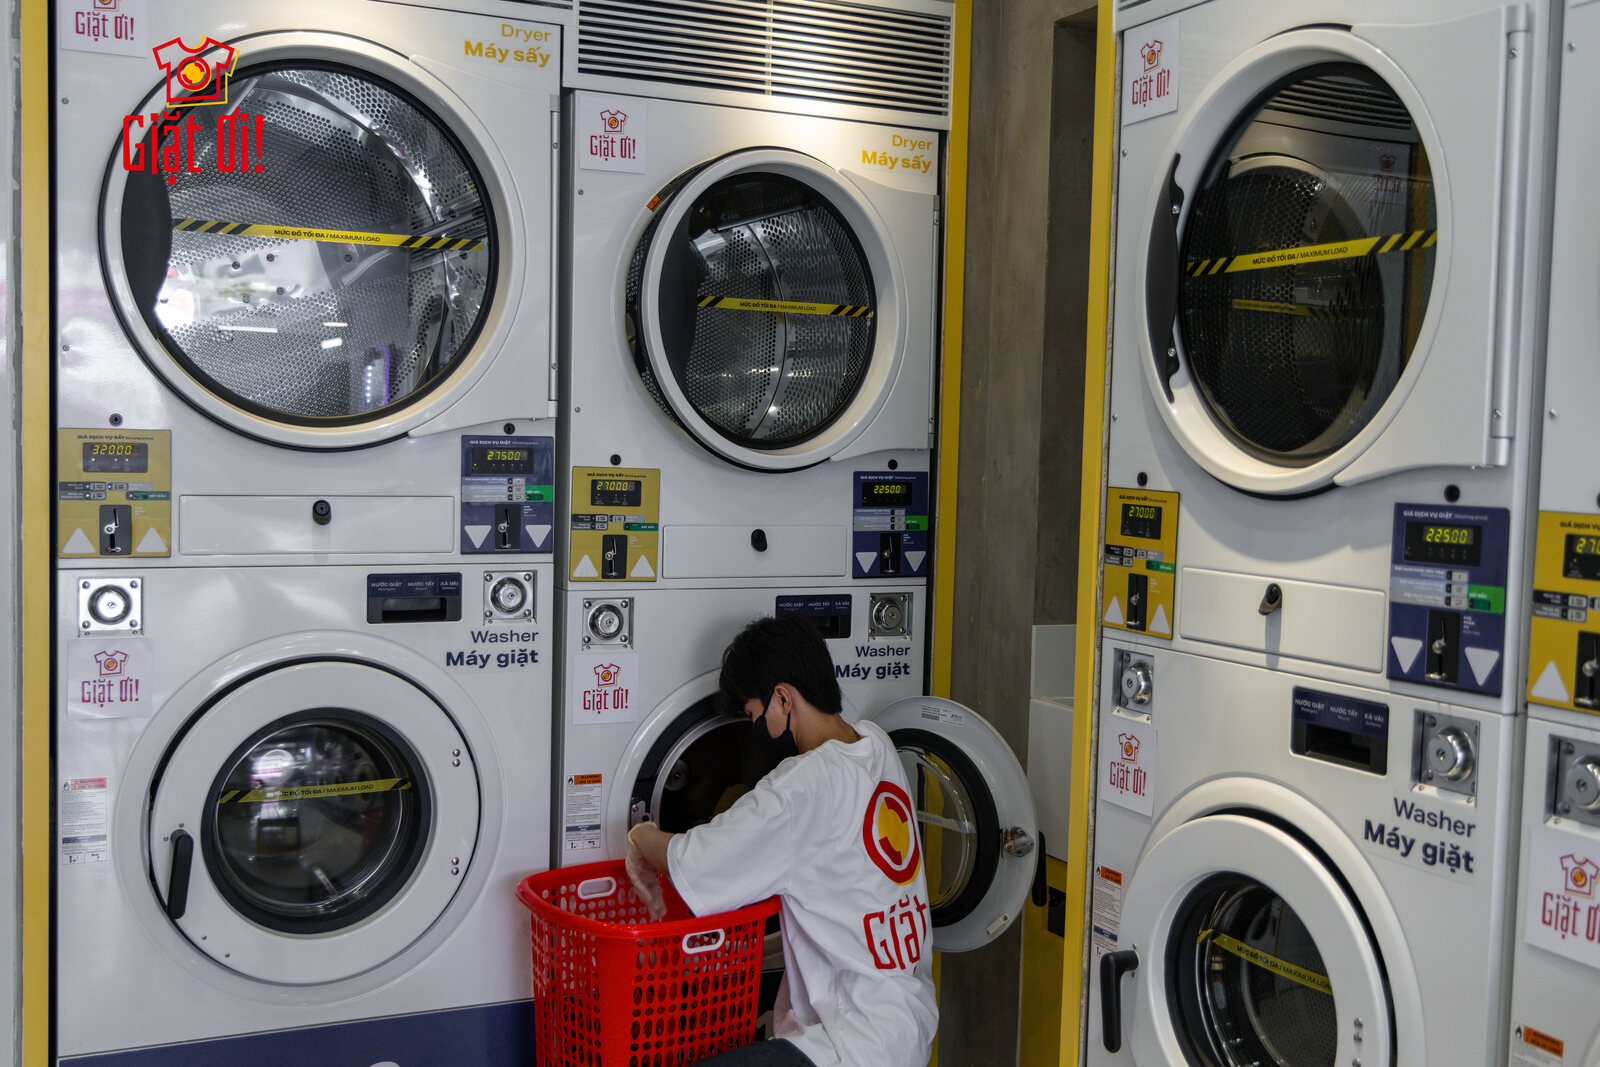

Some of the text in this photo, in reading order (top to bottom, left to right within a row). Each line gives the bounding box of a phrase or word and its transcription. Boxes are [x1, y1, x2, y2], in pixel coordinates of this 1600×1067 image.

[75, 11, 134, 41] Giặt Ơi!
[501, 23, 551, 42] Dryer
[464, 40, 551, 68] Máy sấy
[1132, 75, 1153, 108] Giặt
[590, 135, 636, 161] Giặt Ơi!
[892, 134, 933, 151] Dryer
[862, 149, 932, 174] Máy sấy
[329, 233, 362, 241] MAXIMUM
[1300, 249, 1330, 259] MAXIMUM
[1330, 247, 1348, 255] LOAD
[92, 444, 133, 455] 32000
[487, 450, 521, 461] 27500
[596, 481, 629, 491] 27000
[873, 484, 901, 494] 22500
[1128, 506, 1155, 519] 27000
[1426, 528, 1468, 544] 22500
[470, 629, 539, 644] Washer
[446, 648, 539, 669] Máy giặt
[855, 644, 911, 658] Washer
[835, 661, 910, 680] Máy giặt
[81, 676, 140, 708] Giặt Ơi!
[583, 686, 629, 714] Giặt Ơi!
[1109, 760, 1147, 797] Giặt Ơi!
[1393, 797, 1476, 838] Washer
[1364, 818, 1474, 874] Máy giặt
[1541, 891, 1581, 940] Giặt
[1270, 961, 1279, 970] ĐA
[1283, 965, 1316, 983] MAXIMUM
[1316, 978, 1330, 989] LOA
